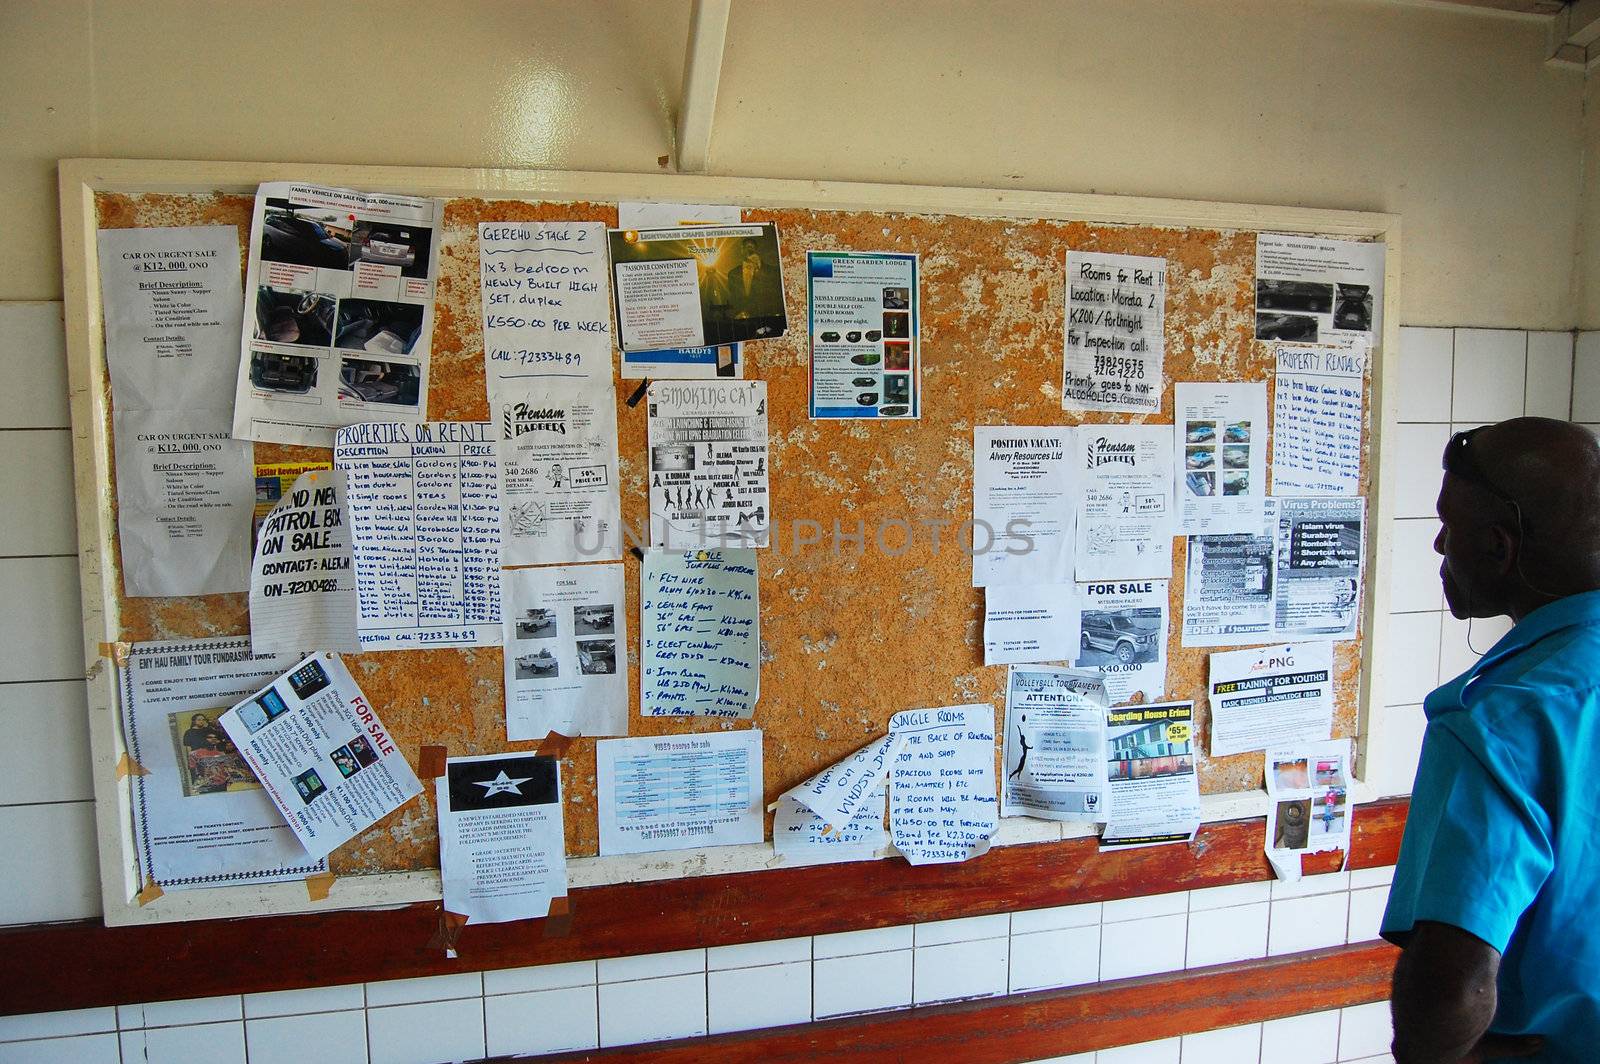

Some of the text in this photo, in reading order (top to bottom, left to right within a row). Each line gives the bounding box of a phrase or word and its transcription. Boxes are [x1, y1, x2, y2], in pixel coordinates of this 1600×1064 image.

[312, 190, 333, 198] VEHICLE
[483, 228, 587, 241] GEREHU STAGE 2
[640, 232, 681, 240] LIGHTHOUSE
[122, 252, 142, 260] CAR
[158, 251, 194, 259] URGENT
[195, 250, 217, 258] SALE
[514, 263, 589, 274] bedroom
[1080, 263, 1153, 286] Rooms for Rent
[159, 281, 203, 289] Description:
[485, 279, 598, 292] NEWLY BUILT HIGH
[519, 294, 562, 307] duplex
[1111, 289, 1143, 308] Morata
[1148, 294, 1155, 309] 2
[1069, 308, 1094, 324] K200
[487, 316, 609, 333] K550.00 PER WEEK
[1067, 330, 1149, 354] For Inspection call:
[1094, 355, 1144, 370] 73829675
[1277, 349, 1361, 373] PROPERTY RENTALS
[1065, 371, 1096, 391] Priority
[1101, 381, 1122, 393] goes
[1124, 380, 1132, 392] to
[659, 388, 726, 410] SMOKING
[513, 403, 566, 420] Hensam
[338, 423, 492, 445] PROPERTIES ON RENT
[515, 422, 566, 436] BARBERS
[411, 445, 492, 455] LOCATION PRICE
[990, 439, 1062, 449] POSITION VACANT:
[1096, 437, 1135, 453] Hensam
[989, 451, 1063, 463] Alvery Resources Ltd
[1096, 455, 1135, 467] BARBERS
[415, 460, 458, 469] Gordons
[417, 471, 457, 479] Gordons
[1282, 500, 1361, 509] Virus Problems?
[264, 511, 320, 537] PATROL
[262, 536, 284, 556] ON
[262, 559, 318, 575] CONTACT:
[660, 573, 704, 584] FLY WIRE
[1088, 583, 1153, 595] FOR SALE
[420, 631, 477, 641] 72333489
[657, 640, 687, 649] ELECT
[139, 651, 254, 670] EMY HAU FAMILY TOUR FUNDRASING
[1269, 657, 1295, 669] PNG
[235, 671, 273, 679] SPECTATORS
[656, 667, 678, 677] Iron
[1015, 678, 1101, 691] VOLLEYBALL TOURNAMENT
[1216, 673, 1325, 693] FREE TRAINING FOR YOUTHS!
[1240, 697, 1267, 706] BUSINESS
[1267, 693, 1302, 703] KNOWLEDGE
[891, 711, 965, 729] SINGLE ROOMS
[1108, 709, 1190, 722] Boarding House Erima
[350, 696, 395, 757] FOR SALE
[908, 732, 963, 745] THE BACK OF
[895, 770, 932, 778] SPACIOUS
